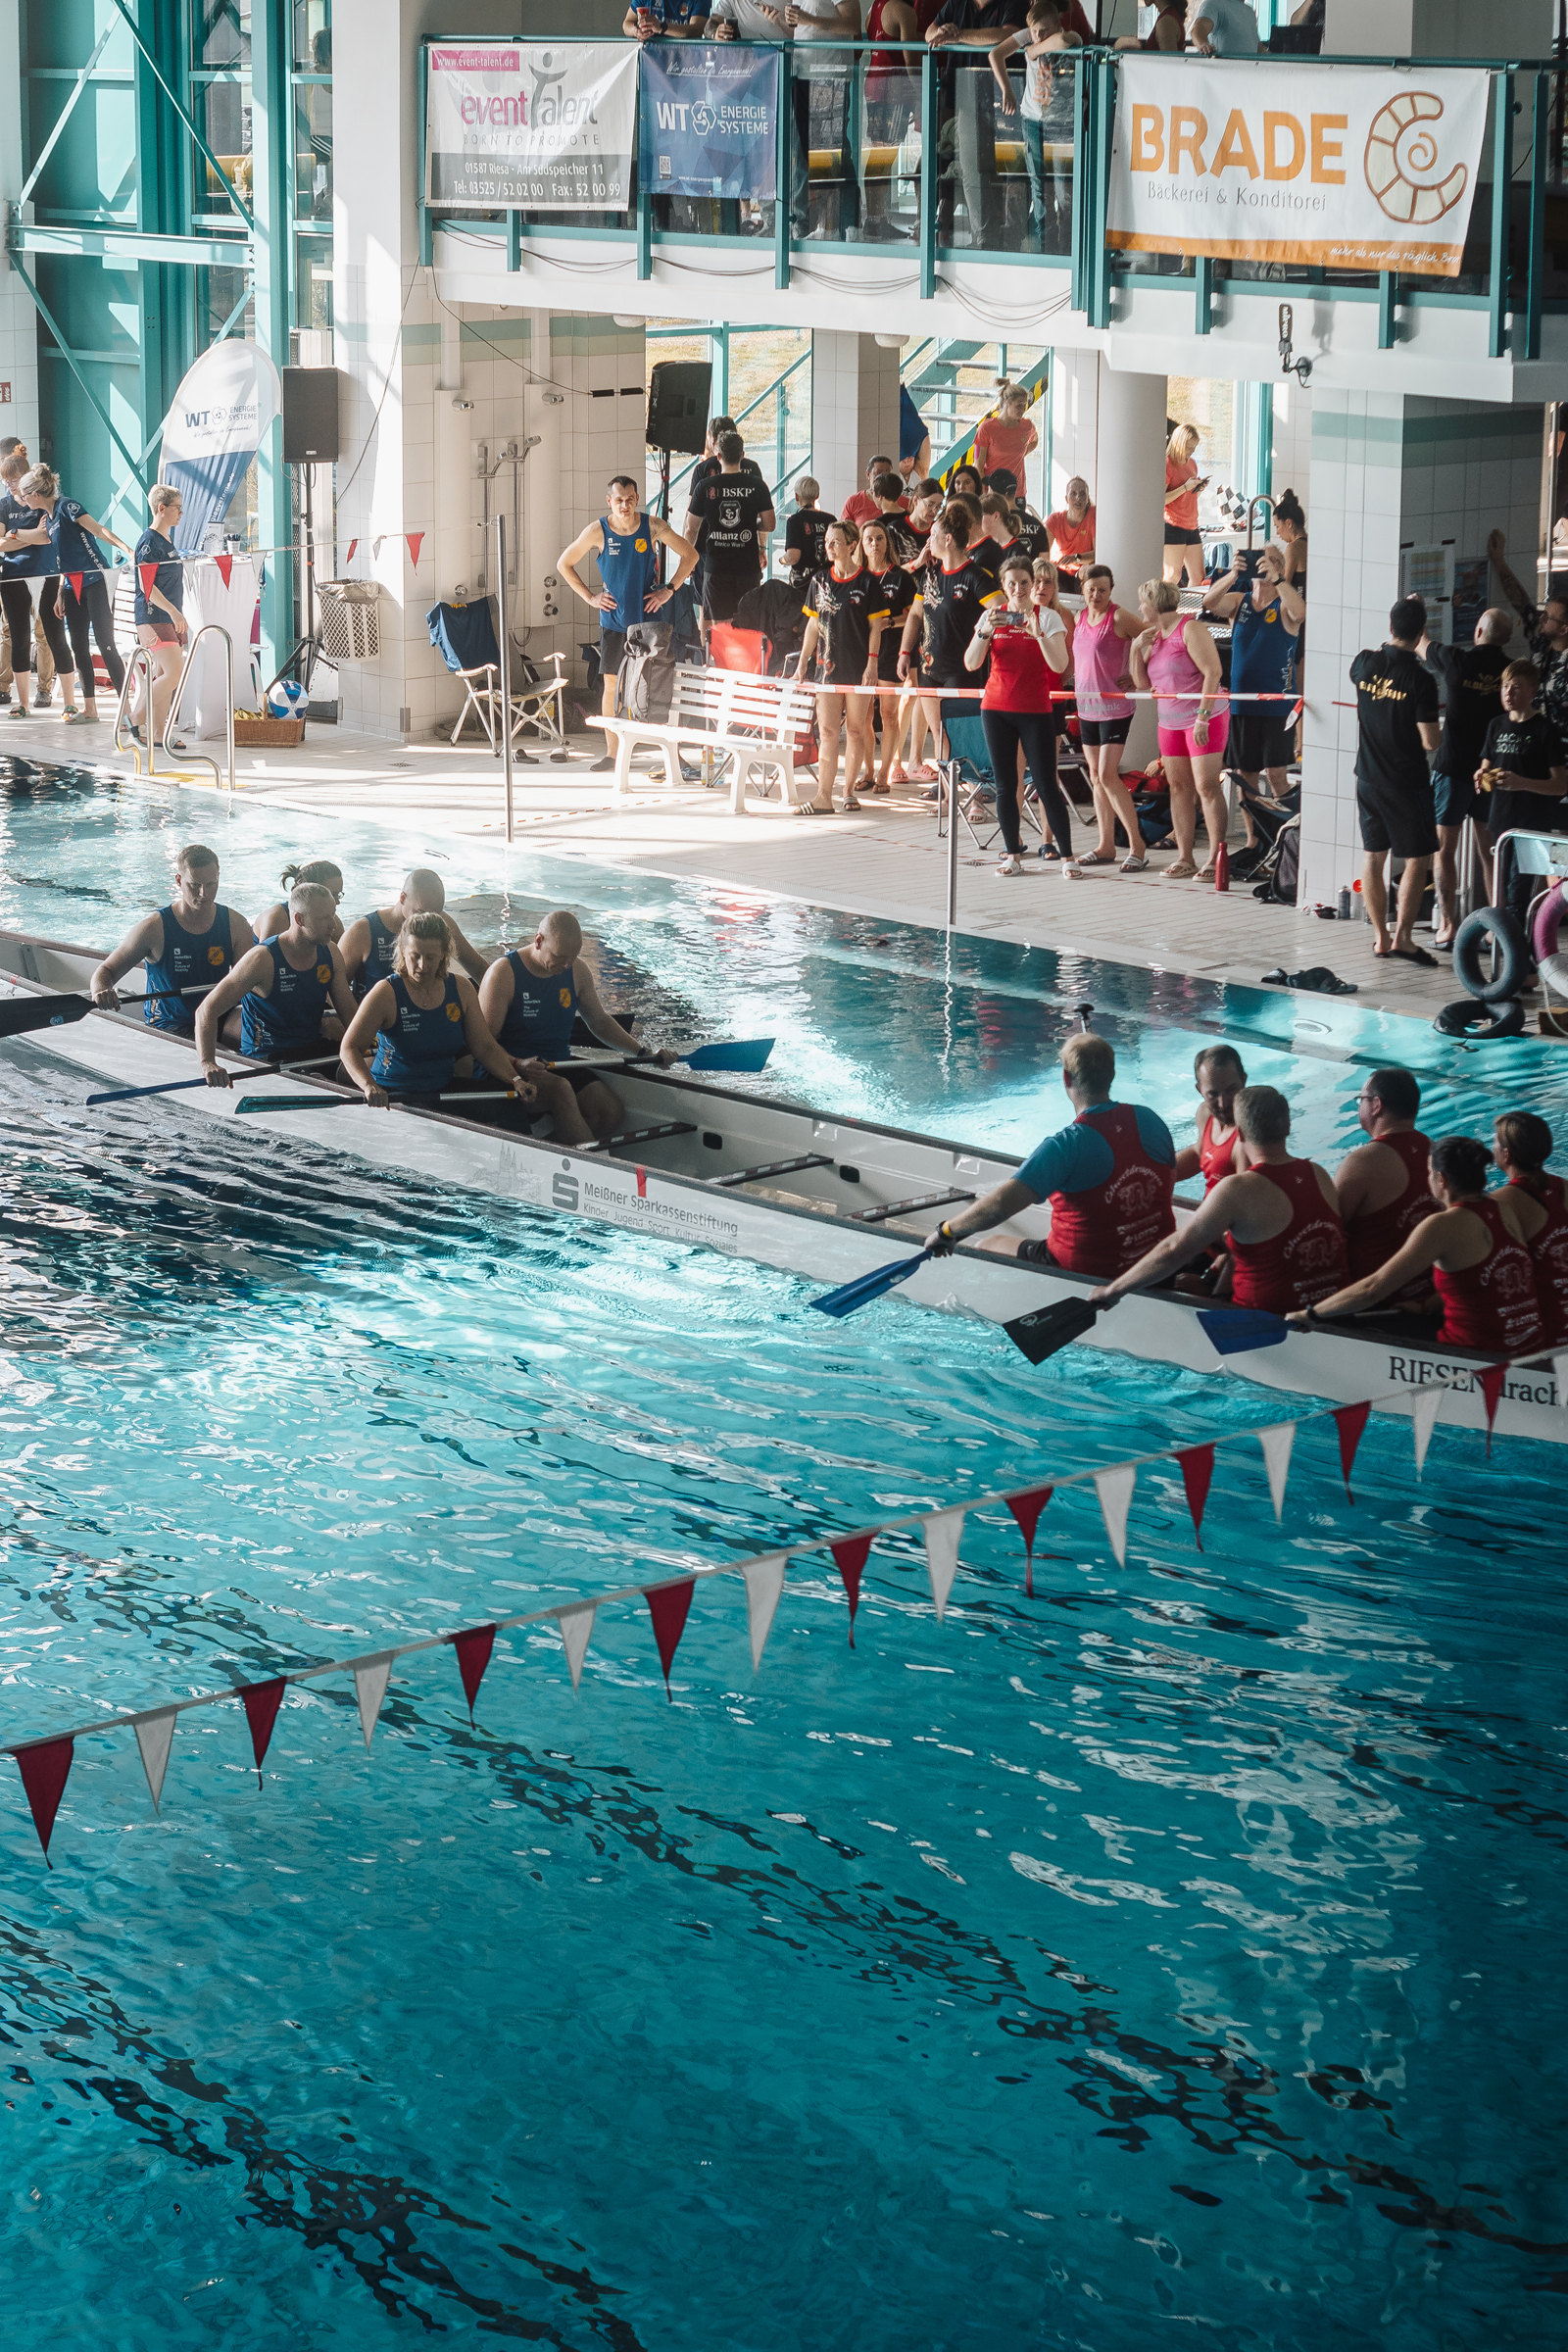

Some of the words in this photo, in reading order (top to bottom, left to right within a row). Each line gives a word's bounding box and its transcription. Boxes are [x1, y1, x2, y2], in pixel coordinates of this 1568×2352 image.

[437, 55, 514, 68] www.event-talent.de
[657, 102, 689, 131] WT
[720, 105, 766, 120] ENERGIE
[719, 121, 768, 134] SYSTEME
[464, 133, 498, 146] BORN
[507, 135, 523, 146] TO
[530, 133, 600, 146] PROMOTE
[1130, 103, 1348, 185] BRADE
[465, 163, 487, 173] 01587
[489, 163, 510, 174] Riesa
[517, 164, 531, 175] Am
[533, 163, 589, 177] Südspeicher
[592, 164, 604, 174] 11
[454, 180, 467, 194] Tel:
[469, 182, 495, 195] 03525
[504, 183, 516, 196] 52
[517, 183, 529, 196] 02
[531, 183, 544, 196] 00
[552, 182, 573, 196] Fax:
[576, 183, 588, 196] 52
[593, 183, 606, 196] 00
[609, 183, 620, 196] 99
[1148, 180, 1208, 204] Bäckerei
[1216, 187, 1227, 204] &
[1236, 187, 1326, 212] Konditorei
[1330, 245, 1354, 256] mehr
[1355, 246, 1366, 257] als
[1386, 249, 1400, 260] das
[229, 405, 257, 414] ENERGIE
[185, 411, 211, 428] WT
[228, 413, 257, 421] SYSTEME
[814, 522, 825, 533] BS
[1020, 524, 1040, 535] SKP
[709, 531, 739, 541] Allianz
[584, 1182, 628, 1205] Meißner
[630, 1195, 738, 1237] Sparkassenstiftung
[583, 1202, 609, 1218] Kinder
[613, 1211, 643, 1228] Jugend
[648, 1220, 670, 1237] Sport
[705, 1236, 738, 1254] Soziales
